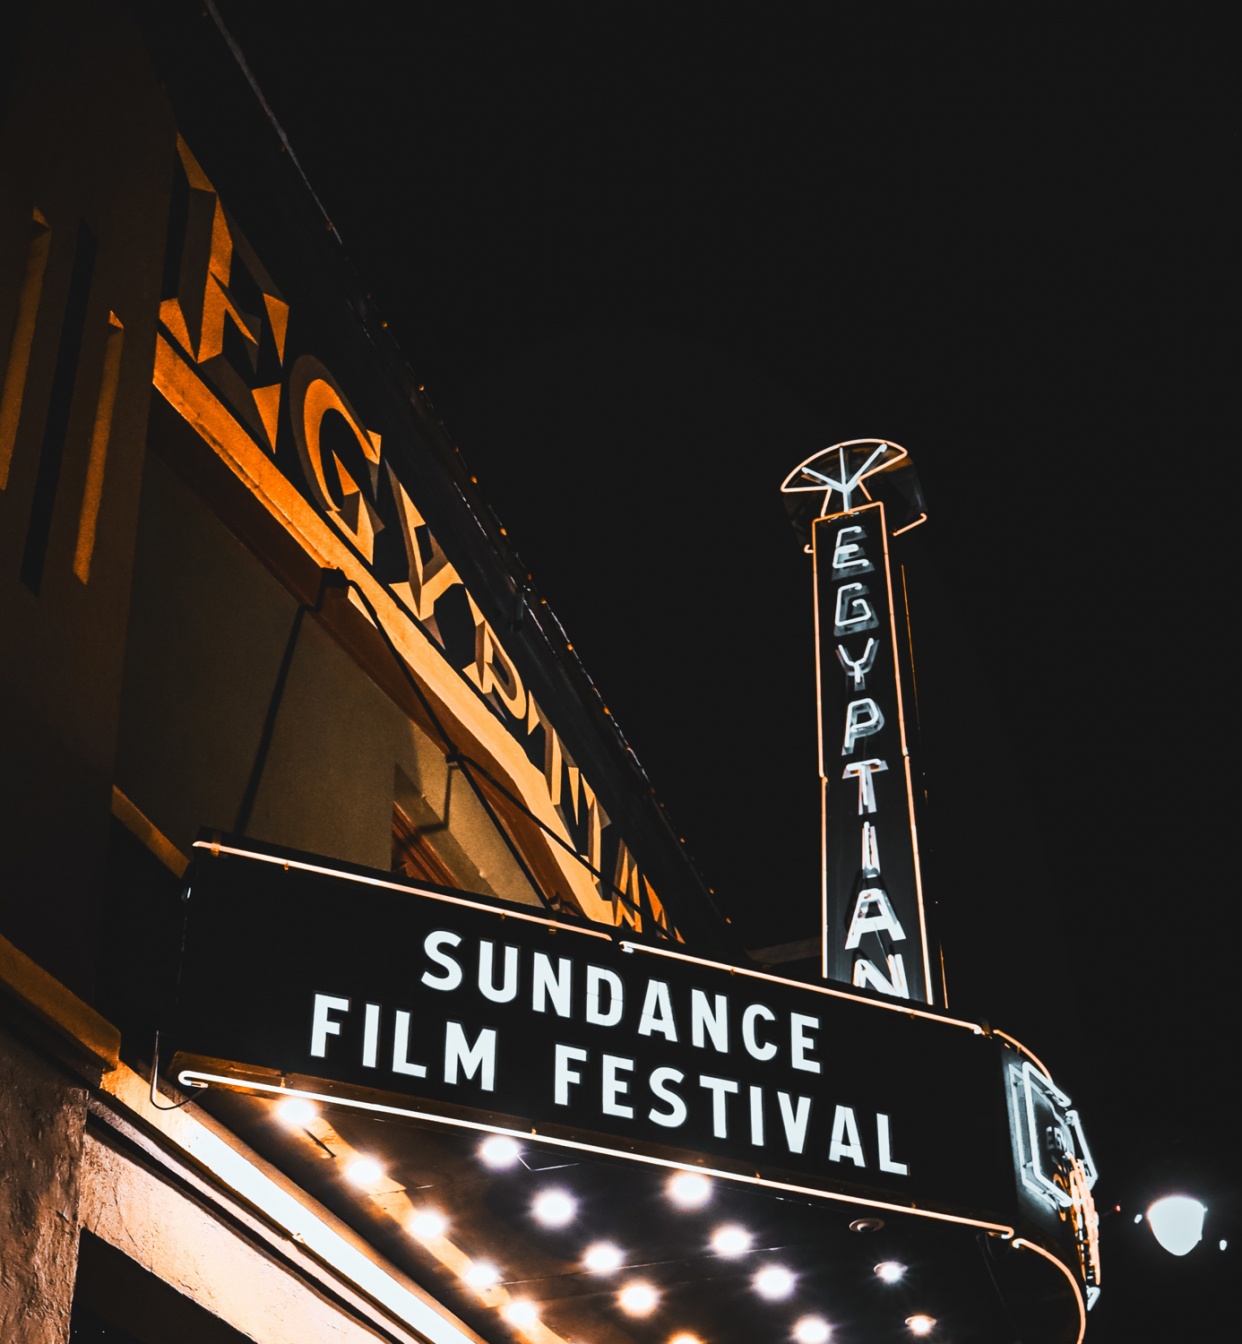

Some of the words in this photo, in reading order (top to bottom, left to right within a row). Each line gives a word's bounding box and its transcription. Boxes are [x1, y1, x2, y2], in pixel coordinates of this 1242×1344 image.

[832, 525, 909, 999] EGYPTIAN
[310, 993, 497, 1092] FILM
[554, 1043, 909, 1176] FESTIVAL
[421, 930, 821, 1074] SUNDANCE
